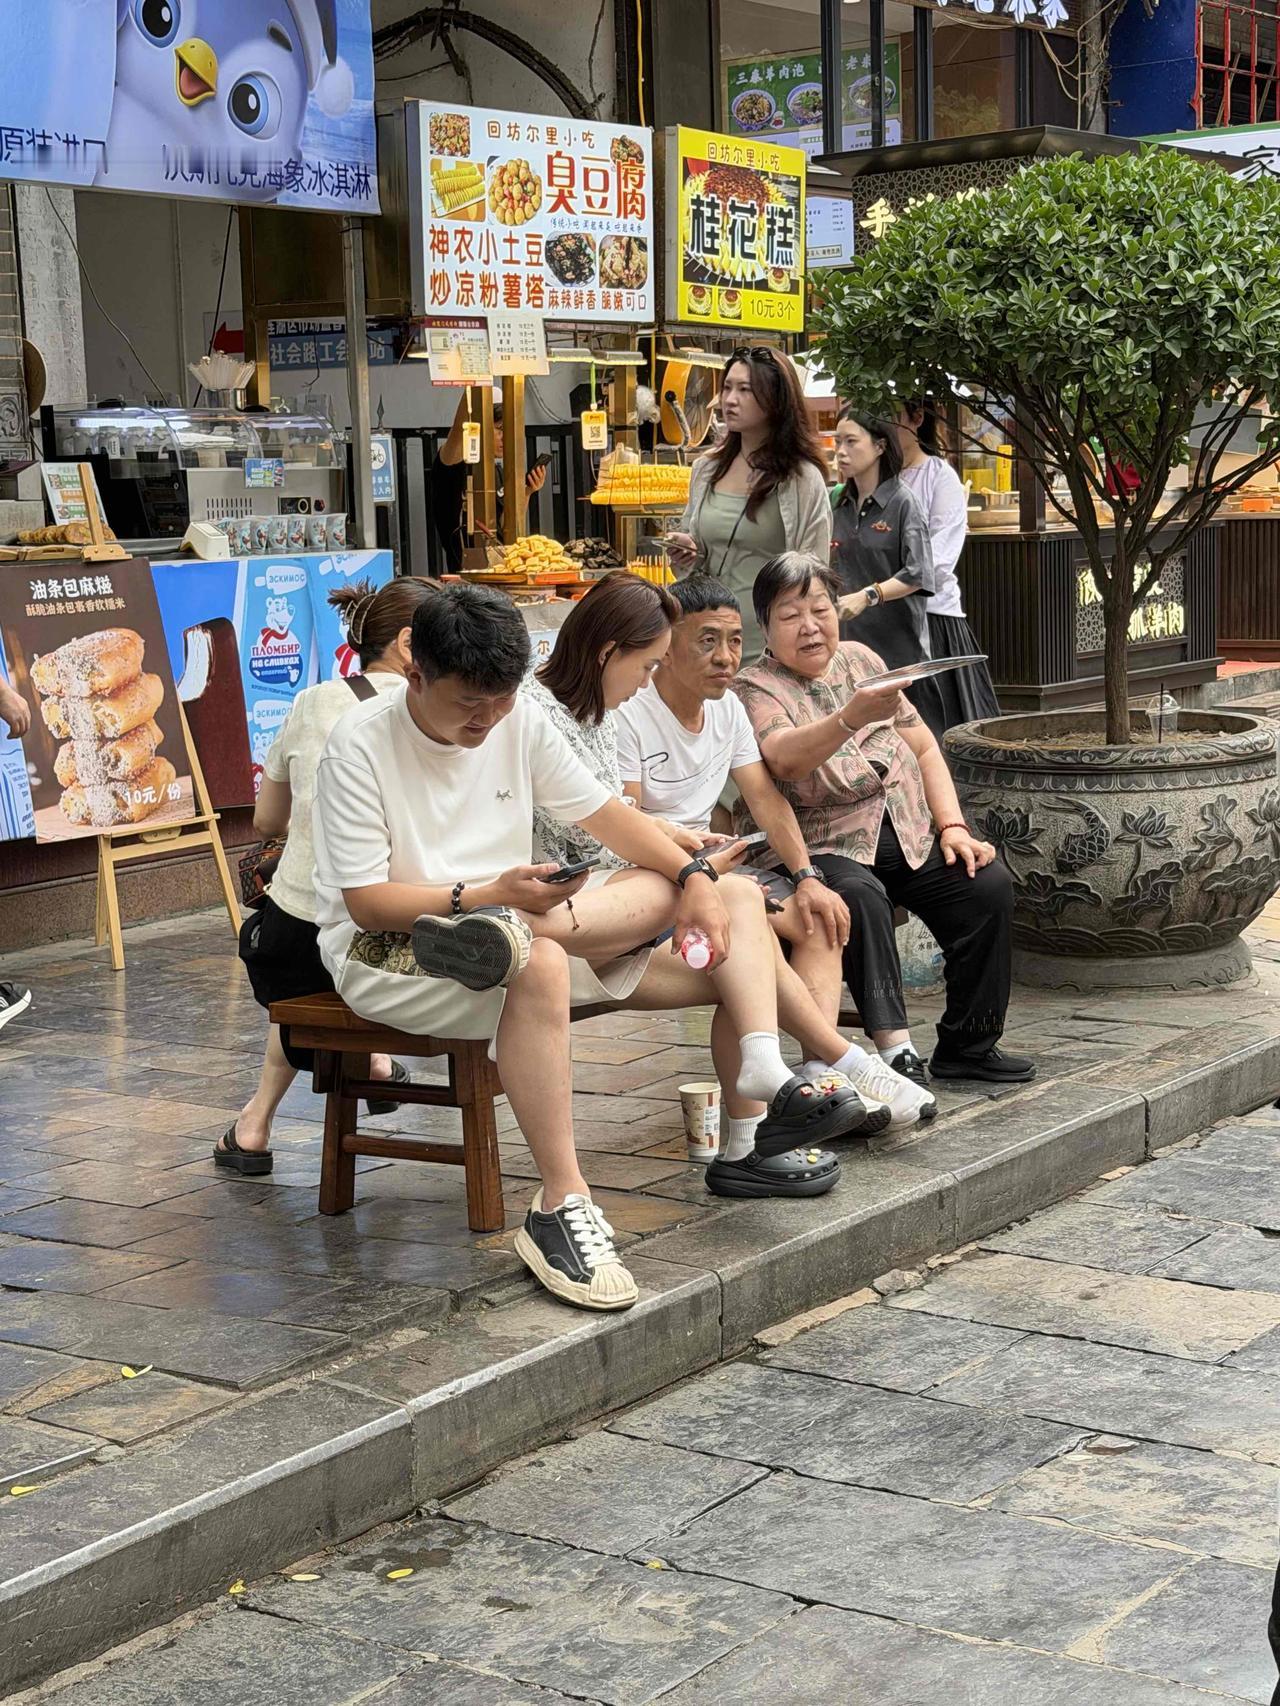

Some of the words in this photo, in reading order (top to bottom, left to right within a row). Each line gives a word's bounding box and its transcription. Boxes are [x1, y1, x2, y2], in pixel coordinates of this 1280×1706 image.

[487, 121, 595, 149] 回坊尔里小吃
[707, 142, 781, 171] 回坊尔里小吃
[546, 150, 646, 221] 臭豆腐
[689, 193, 796, 268] 桂花糕
[429, 224, 544, 268] 神农小土豆
[429, 269, 545, 309] 炒凉粉薯塔
[548, 290, 596, 311] 麻辣鲜香
[601, 291, 647, 312] 脆嫩可口
[270, 336, 386, 366] 社会路工会站
[268, 573, 306, 584] ЭСКИМОС
[252, 643, 300, 657] ПЛОМБИР
[125, 783, 182, 804] 10元/份
